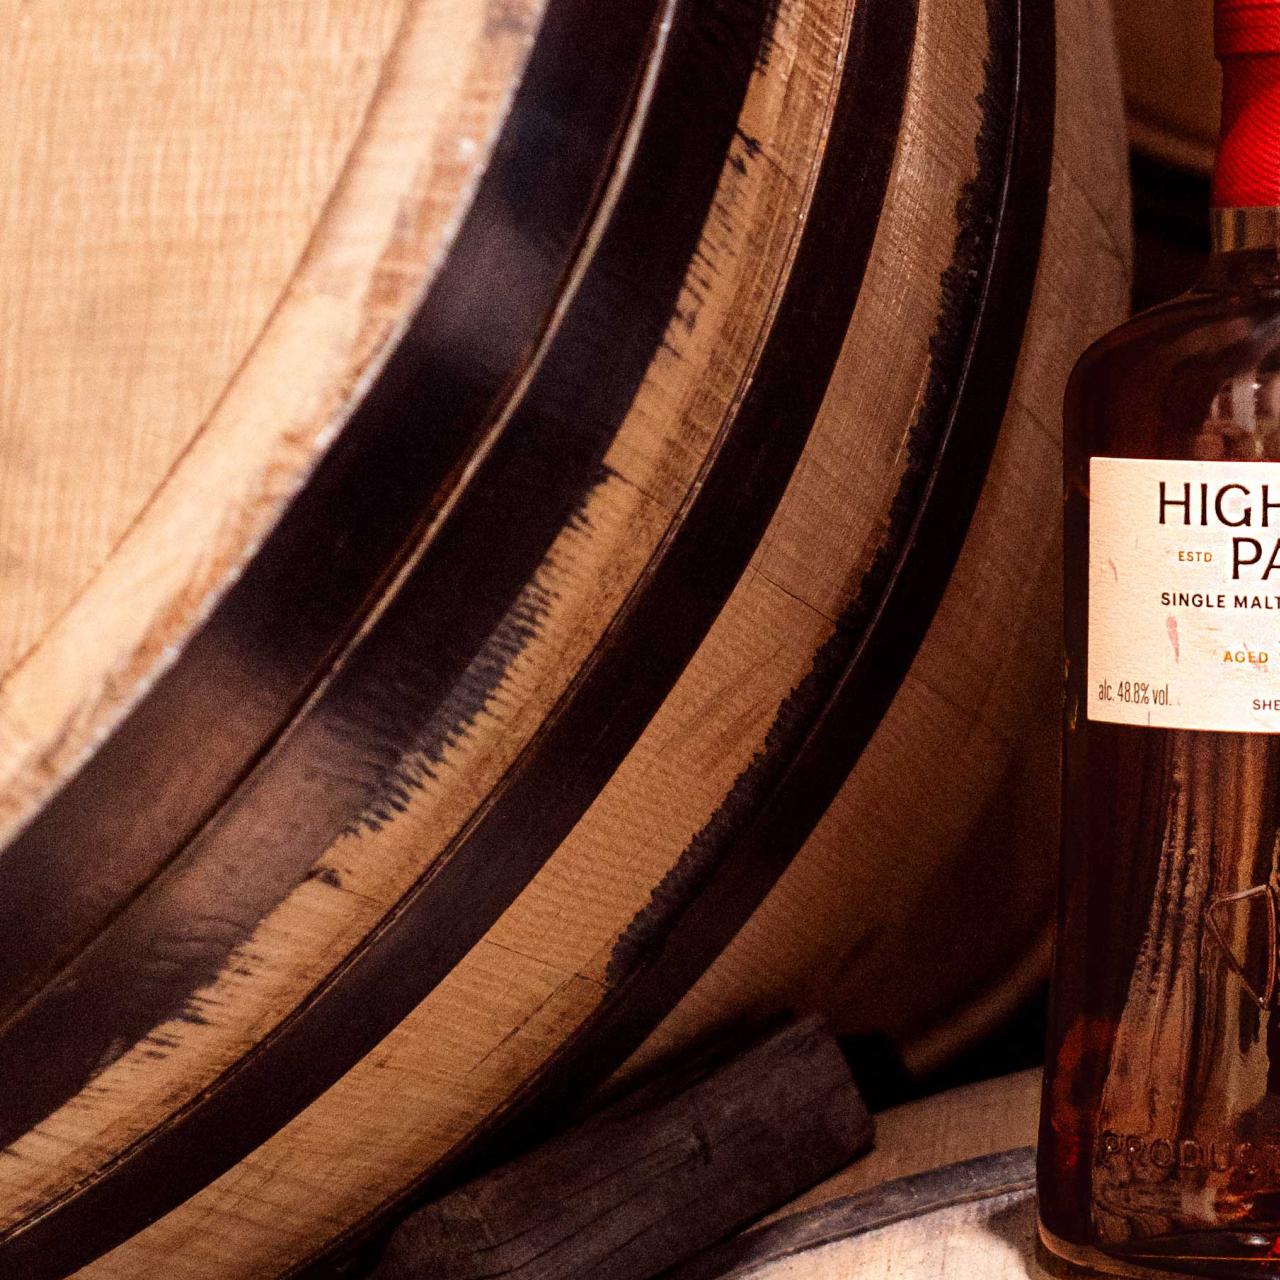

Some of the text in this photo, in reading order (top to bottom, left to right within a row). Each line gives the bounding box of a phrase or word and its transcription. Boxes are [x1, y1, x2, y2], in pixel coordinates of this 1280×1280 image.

[1178, 551, 1213, 564] ESTD
[1161, 592, 1226, 609] SINGLE
[1223, 650, 1269, 665] AGED
[1098, 677, 1172, 706] alc. 48.8% vol.
